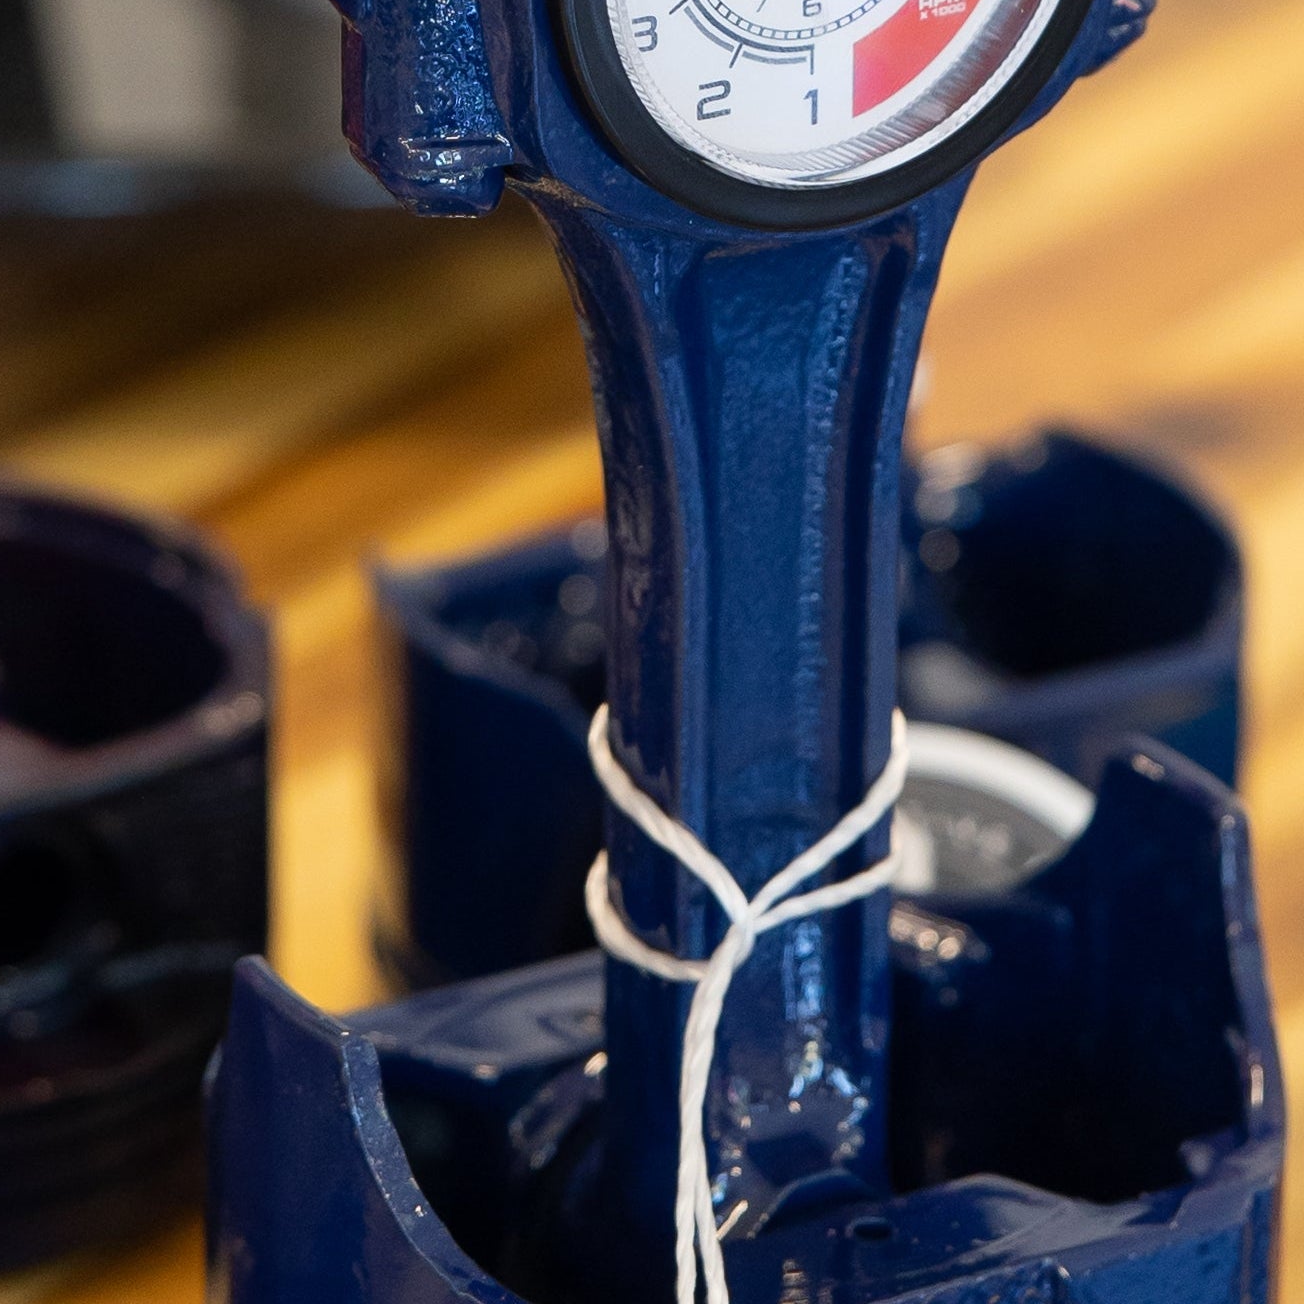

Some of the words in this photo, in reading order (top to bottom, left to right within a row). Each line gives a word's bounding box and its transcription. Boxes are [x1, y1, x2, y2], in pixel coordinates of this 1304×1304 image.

[631, 15, 659, 53] 3
[696, 79, 732, 121] 2
[803, 88, 819, 126] 1
